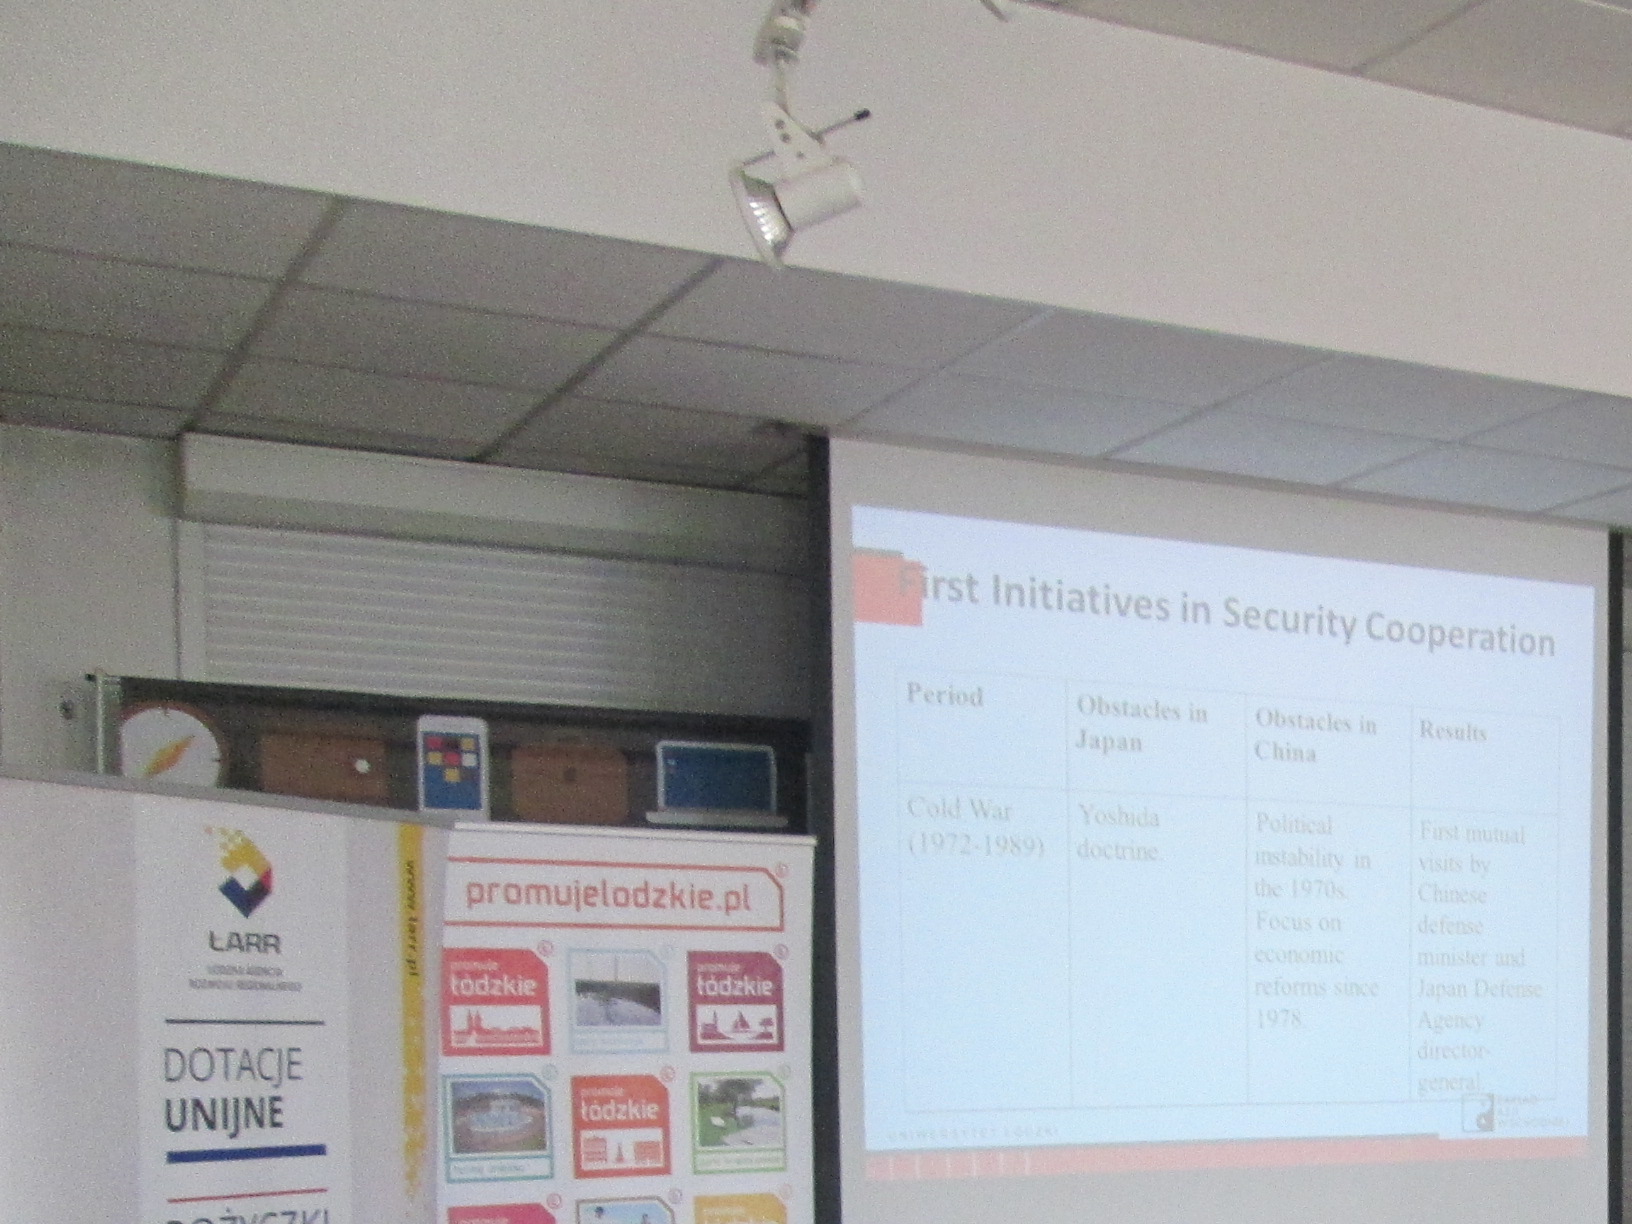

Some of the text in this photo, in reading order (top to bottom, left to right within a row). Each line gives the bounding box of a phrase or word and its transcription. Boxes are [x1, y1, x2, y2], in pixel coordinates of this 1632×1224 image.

[992, 571, 1171, 623] Initiatives
[1182, 592, 1211, 626] in
[1222, 597, 1357, 645] Security
[1366, 611, 1557, 658] Cooperation
[907, 681, 984, 707] Period
[1077, 693, 1208, 723] Obstacles in
[1255, 706, 1377, 736] Obstacles in
[1419, 718, 1487, 742] Results
[1075, 728, 1143, 756] Japan
[1254, 740, 1317, 764] China
[907, 795, 1012, 822] Cold War
[1078, 803, 1160, 828] Yoshida
[1256, 812, 1333, 836] Political
[1419, 820, 1526, 845] First mutual
[908, 831, 1044, 858] (1972-1989)
[1255, 846, 1372, 873] instability in
[1418, 853, 1492, 878] visits by
[466, 879, 750, 914] promujelodzkie.pl
[1255, 878, 1282, 897] the
[1418, 882, 1487, 904] Chinese
[1256, 911, 1342, 932] Focus on
[1418, 914, 1484, 935] defense
[1254, 945, 1344, 965] economic
[1418, 947, 1526, 967] minister and
[1255, 977, 1379, 998] reforms since
[1417, 978, 1543, 1001] Japan Defense
[1418, 1011, 1485, 1033] Agency
[1417, 1040, 1493, 1061] director-
[164, 1047, 303, 1088] DOTACJE
[166, 1096, 283, 1139] UNIJNE
